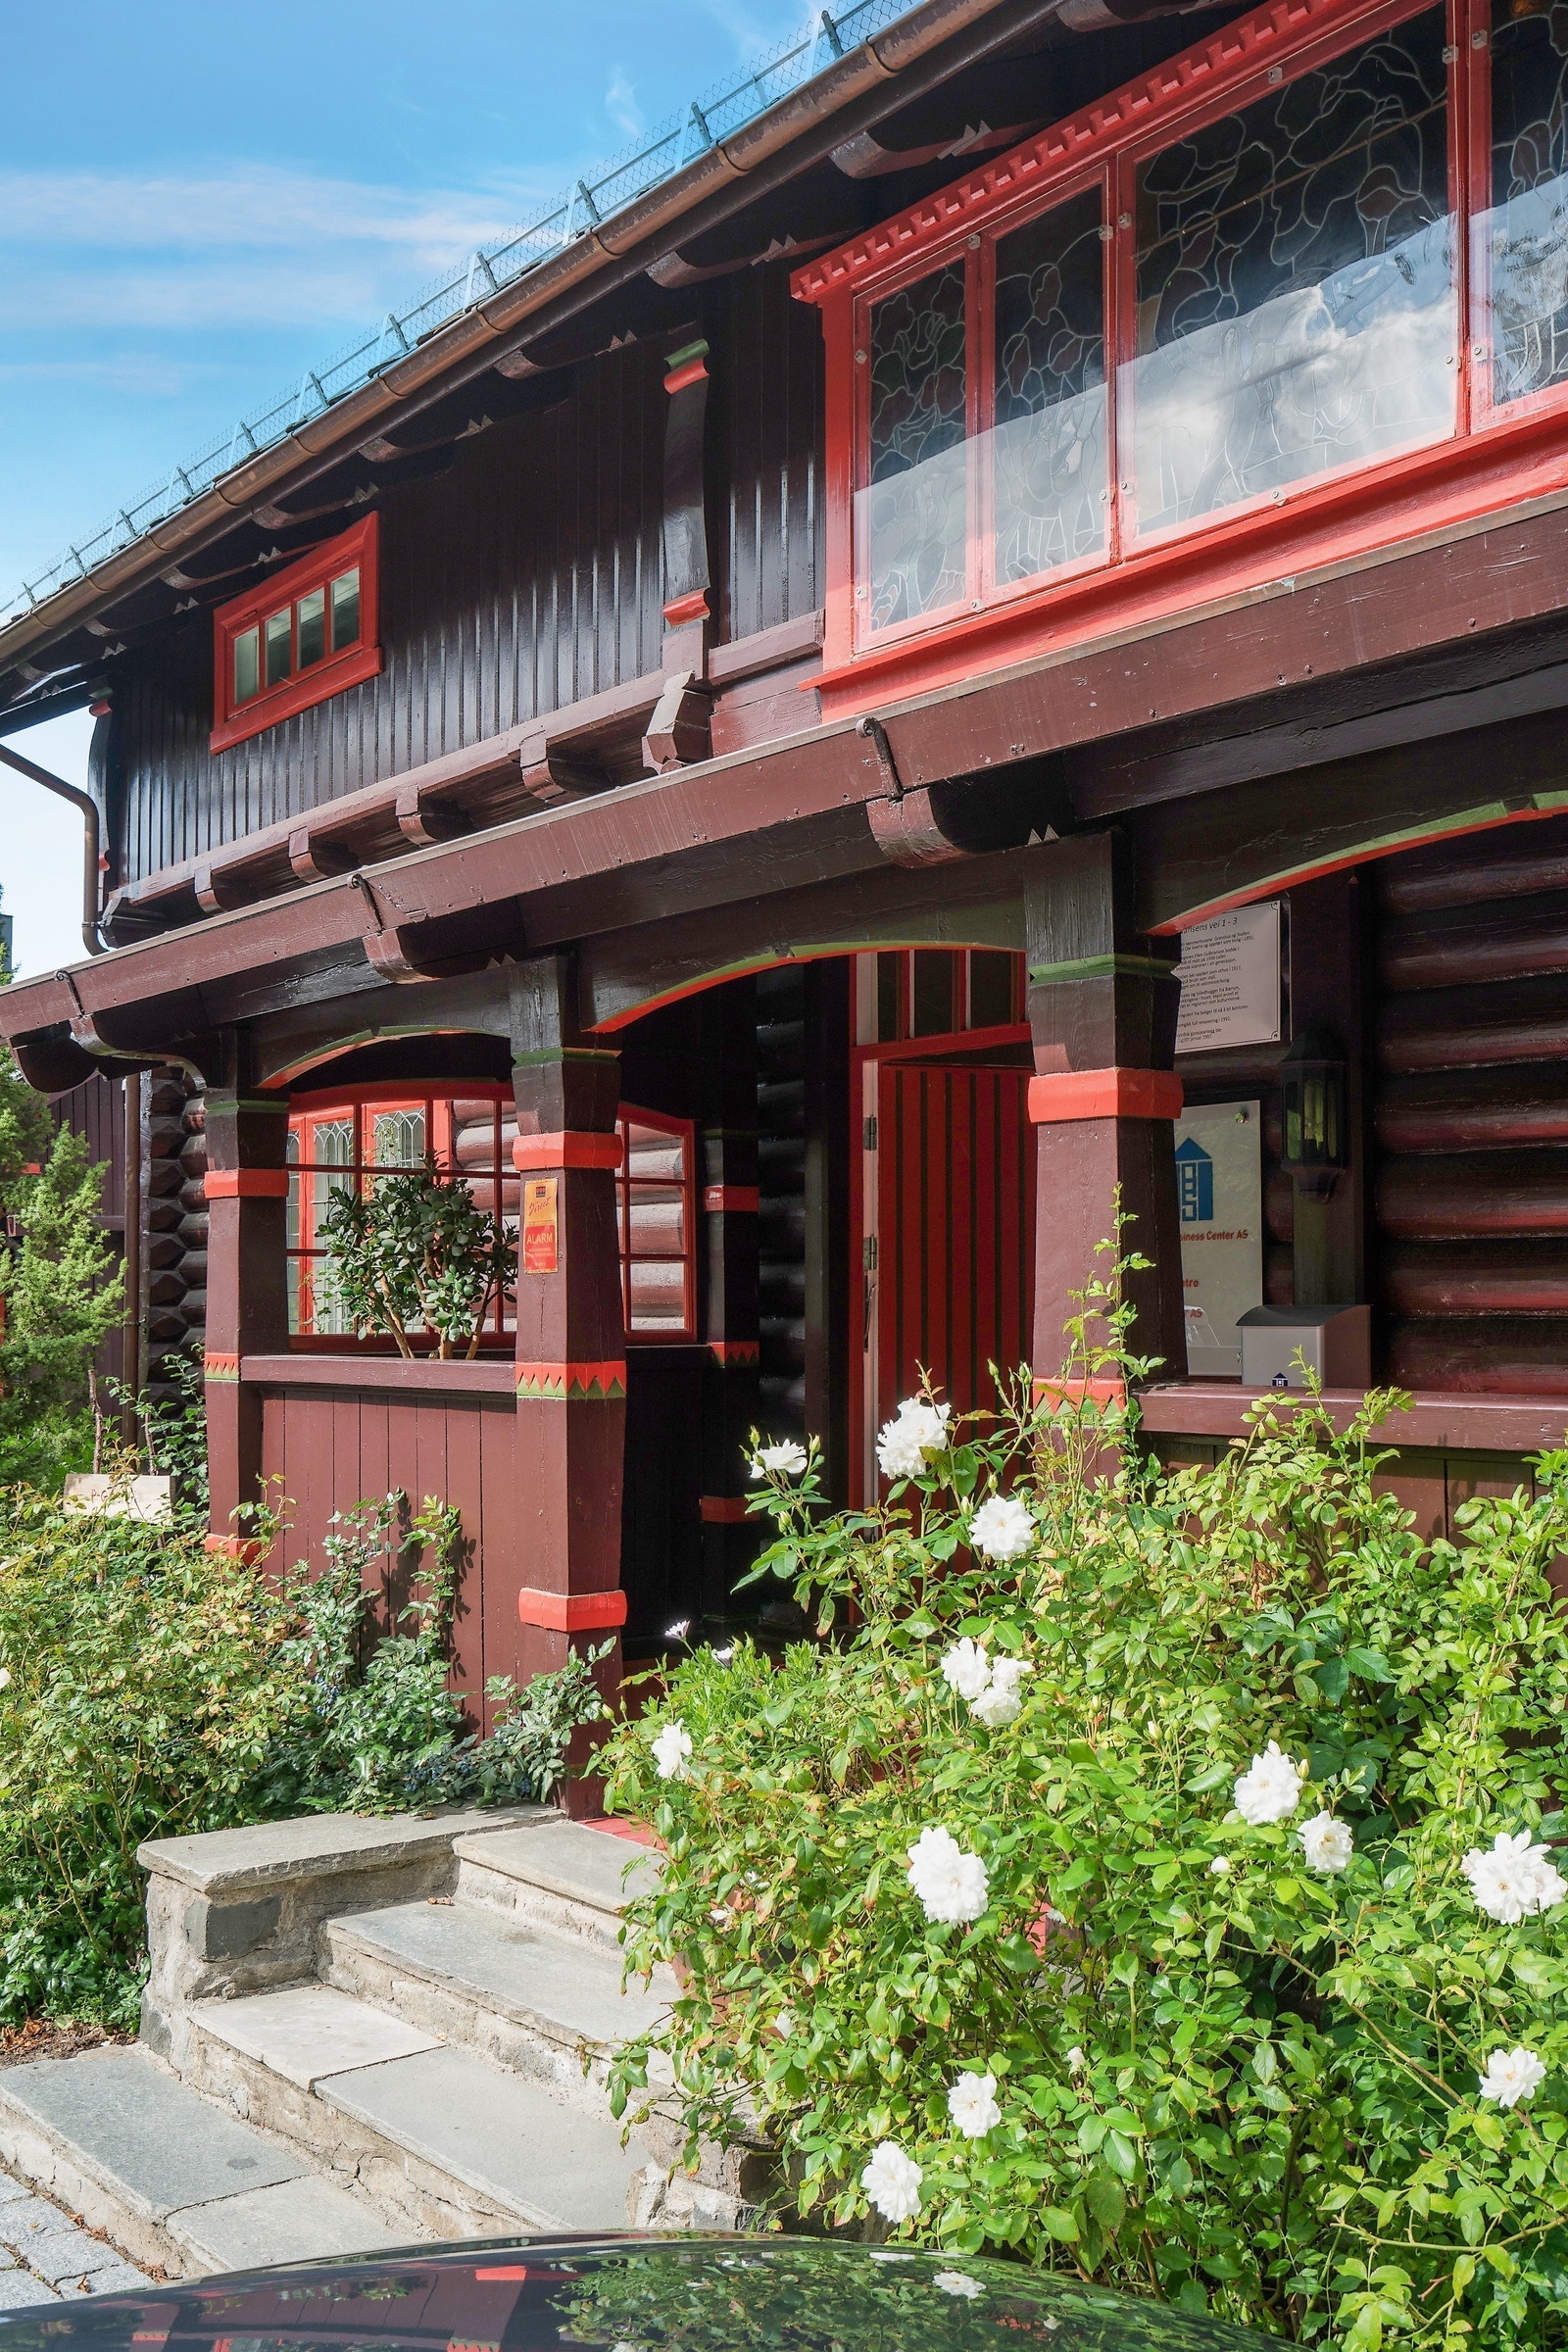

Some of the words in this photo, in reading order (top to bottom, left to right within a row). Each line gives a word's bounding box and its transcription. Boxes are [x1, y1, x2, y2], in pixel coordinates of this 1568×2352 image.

[1209, 920, 1220, 929] vei
[526, 1232, 553, 1244] ALARM
[1180, 1232, 1204, 1242] siness
[1206, 1230, 1235, 1241] Center
[1236, 1229, 1249, 1239] AS
[1190, 1308, 1202, 1318] AS
